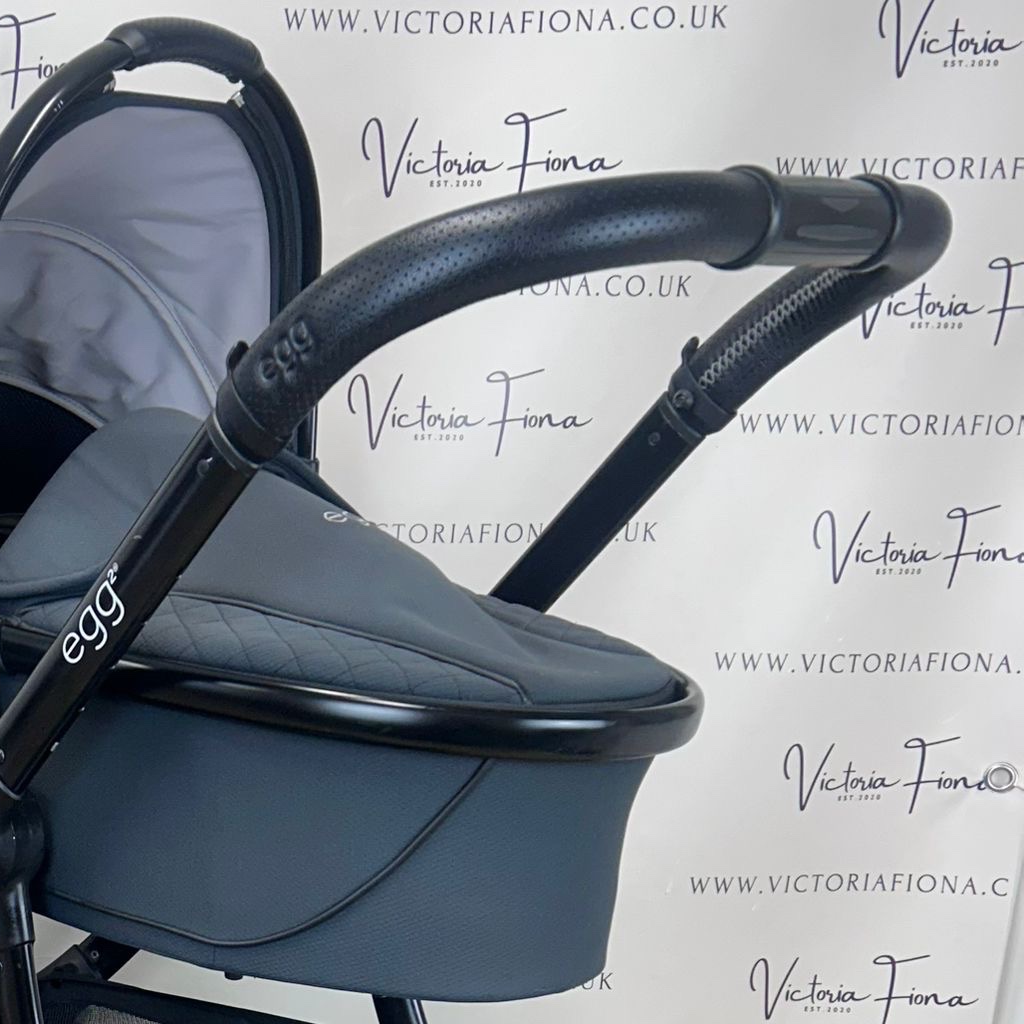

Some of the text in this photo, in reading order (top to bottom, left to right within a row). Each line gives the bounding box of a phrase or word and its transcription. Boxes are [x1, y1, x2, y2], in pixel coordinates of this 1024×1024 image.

[284, 5, 727, 35] WWW.VICTORIAFIONA.CO.UK
[879, 0, 1023, 78] Victoria
[942, 59, 1000, 68] EST.2020
[361, 108, 623, 198] Victoria Fiona
[429, 179, 483, 188] EST.2020
[347, 368, 593, 457] Victoria Fiona
[813, 510, 942, 584] Victoria
[715, 652, 1022, 675] WWW.VICTORIAFIONA.
[783, 743, 901, 811] Victoria
[690, 873, 1009, 898] WWW.VICTORIAFIONA.C
[750, 957, 871, 1020] Victoria
